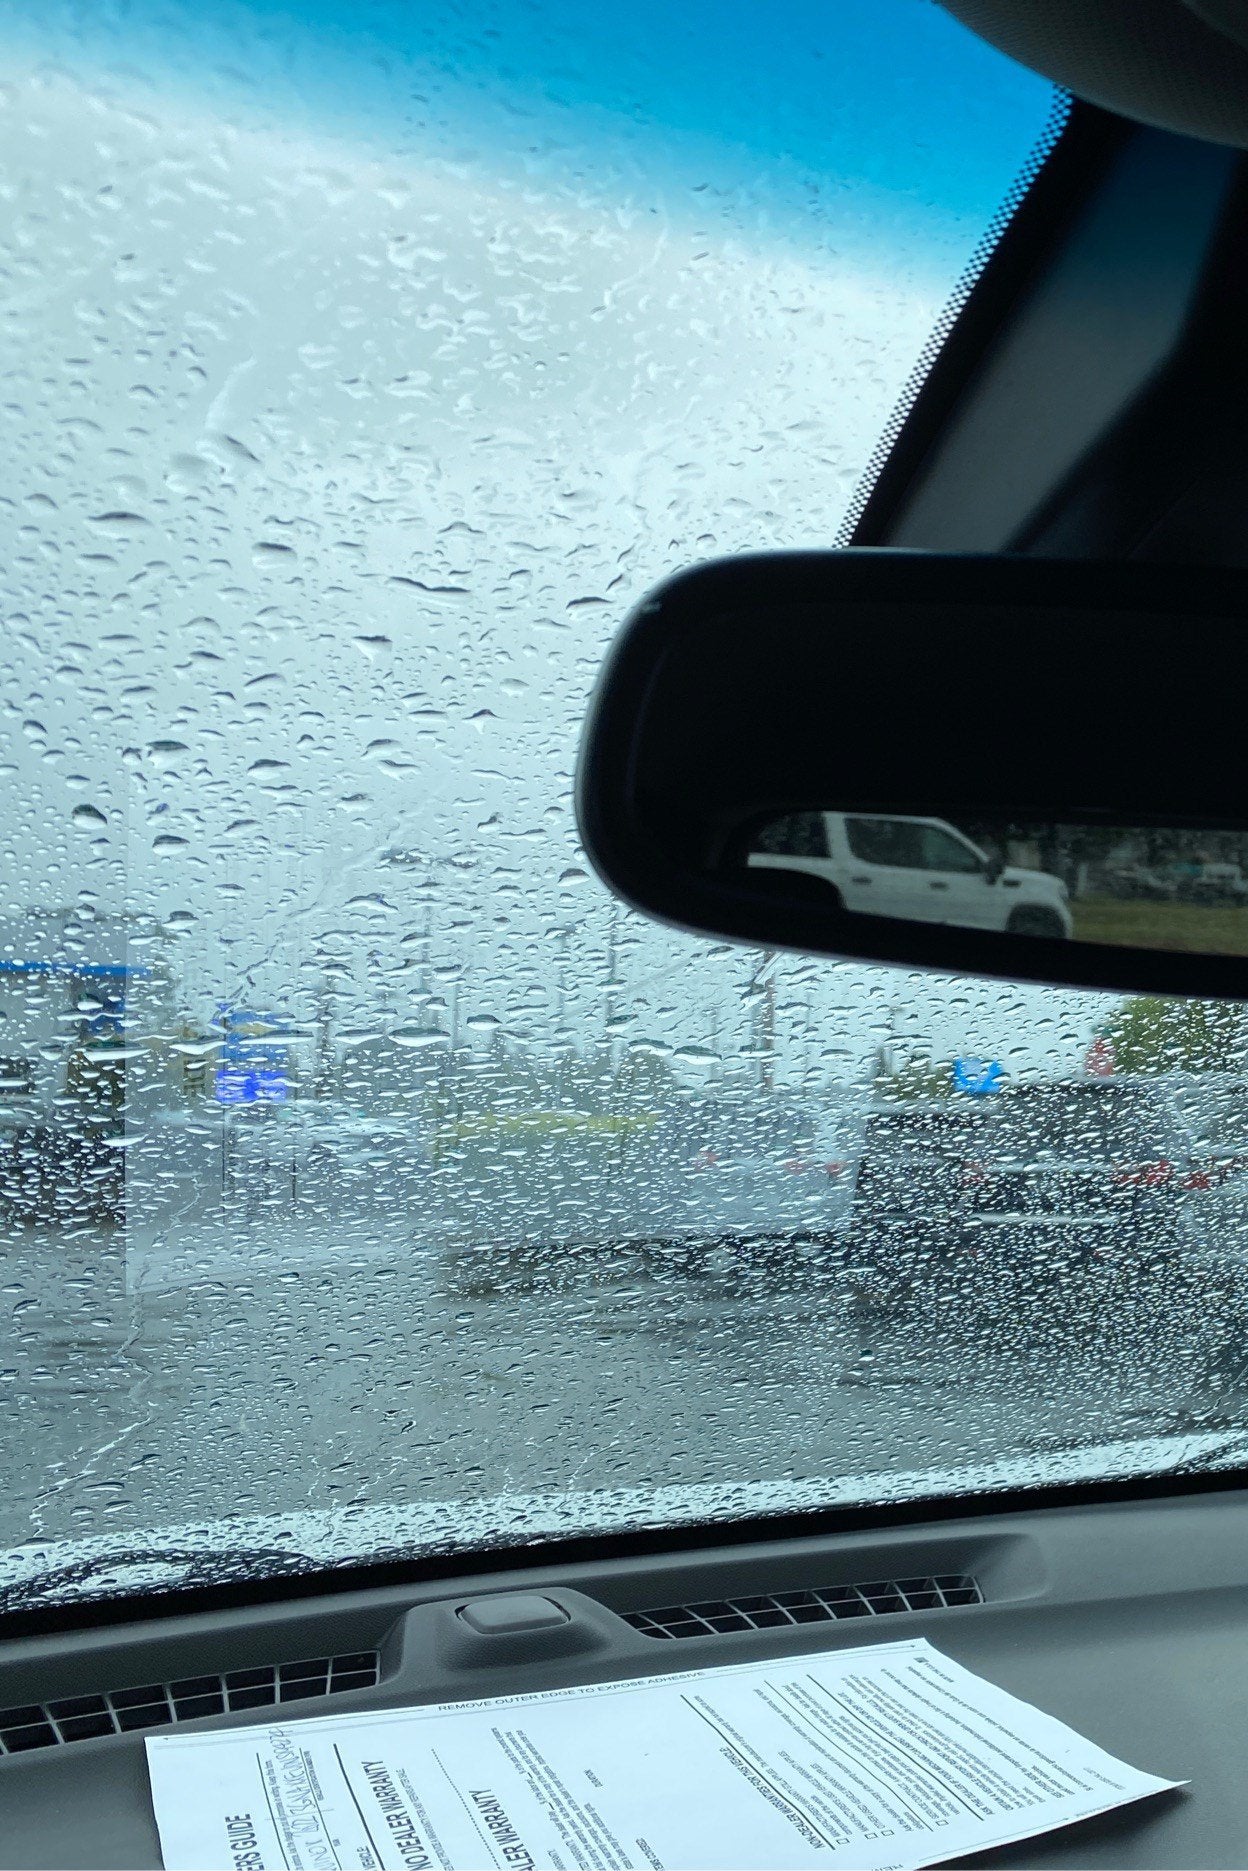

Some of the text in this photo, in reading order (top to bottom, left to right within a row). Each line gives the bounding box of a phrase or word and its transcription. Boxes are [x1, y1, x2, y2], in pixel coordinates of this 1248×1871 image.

[438, 1671, 706, 1711] REMOVE OUTER EDGE TO EXPOSE ADHESIVE
[225, 1814, 257, 1850] GUIDE
[362, 1761, 433, 1870] NO DEALER WARRANTY
[469, 1790, 520, 1845] WARRANTY
